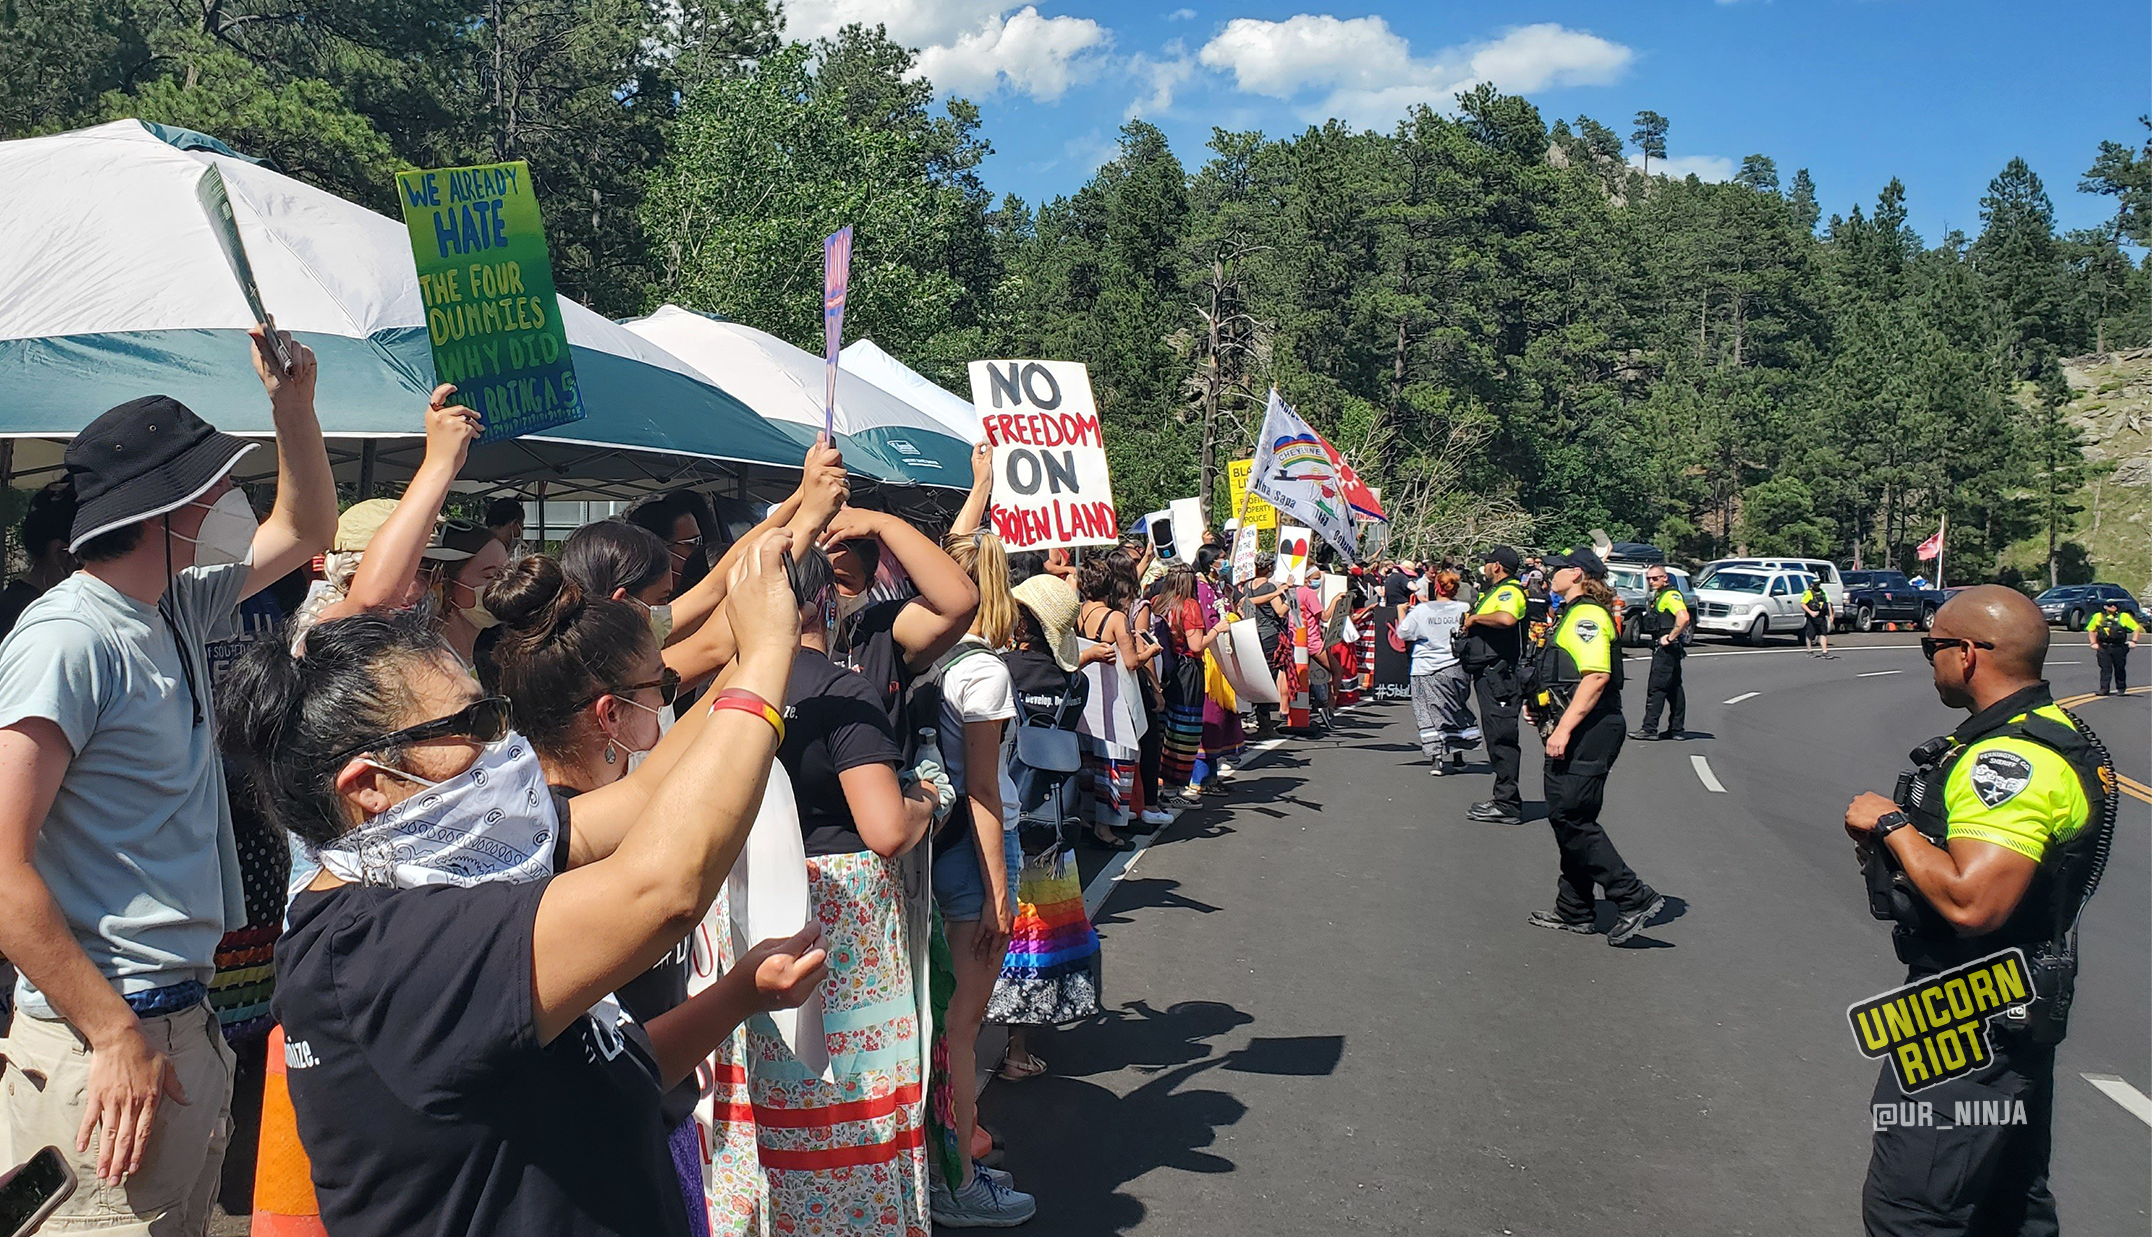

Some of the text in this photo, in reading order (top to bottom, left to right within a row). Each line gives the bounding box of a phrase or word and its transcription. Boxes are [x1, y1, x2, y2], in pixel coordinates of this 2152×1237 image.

[403, 167, 519, 207] WE ALREADY
[433, 199, 508, 258] HATE
[419, 261, 525, 307] THE FOUR
[430, 296, 545, 346] DUMMIES
[437, 332, 559, 384] WHY DID
[484, 377, 542, 424] BRING
[544, 376, 559, 409] A
[986, 362, 1062, 411] NO
[983, 412, 1102, 448] FREEDOM
[1006, 448, 1079, 495] ON
[1233, 466, 1252, 478] BLA
[991, 499, 1118, 547] STOLEN LAND
[1237, 504, 1271, 514] POPERTY
[1244, 514, 1268, 524] POLICE
[1443, 616, 1459, 625] OGLA
[1980, 752, 2022, 763] PENNINGTON
[1989, 758, 2018, 768] SHERIFF
